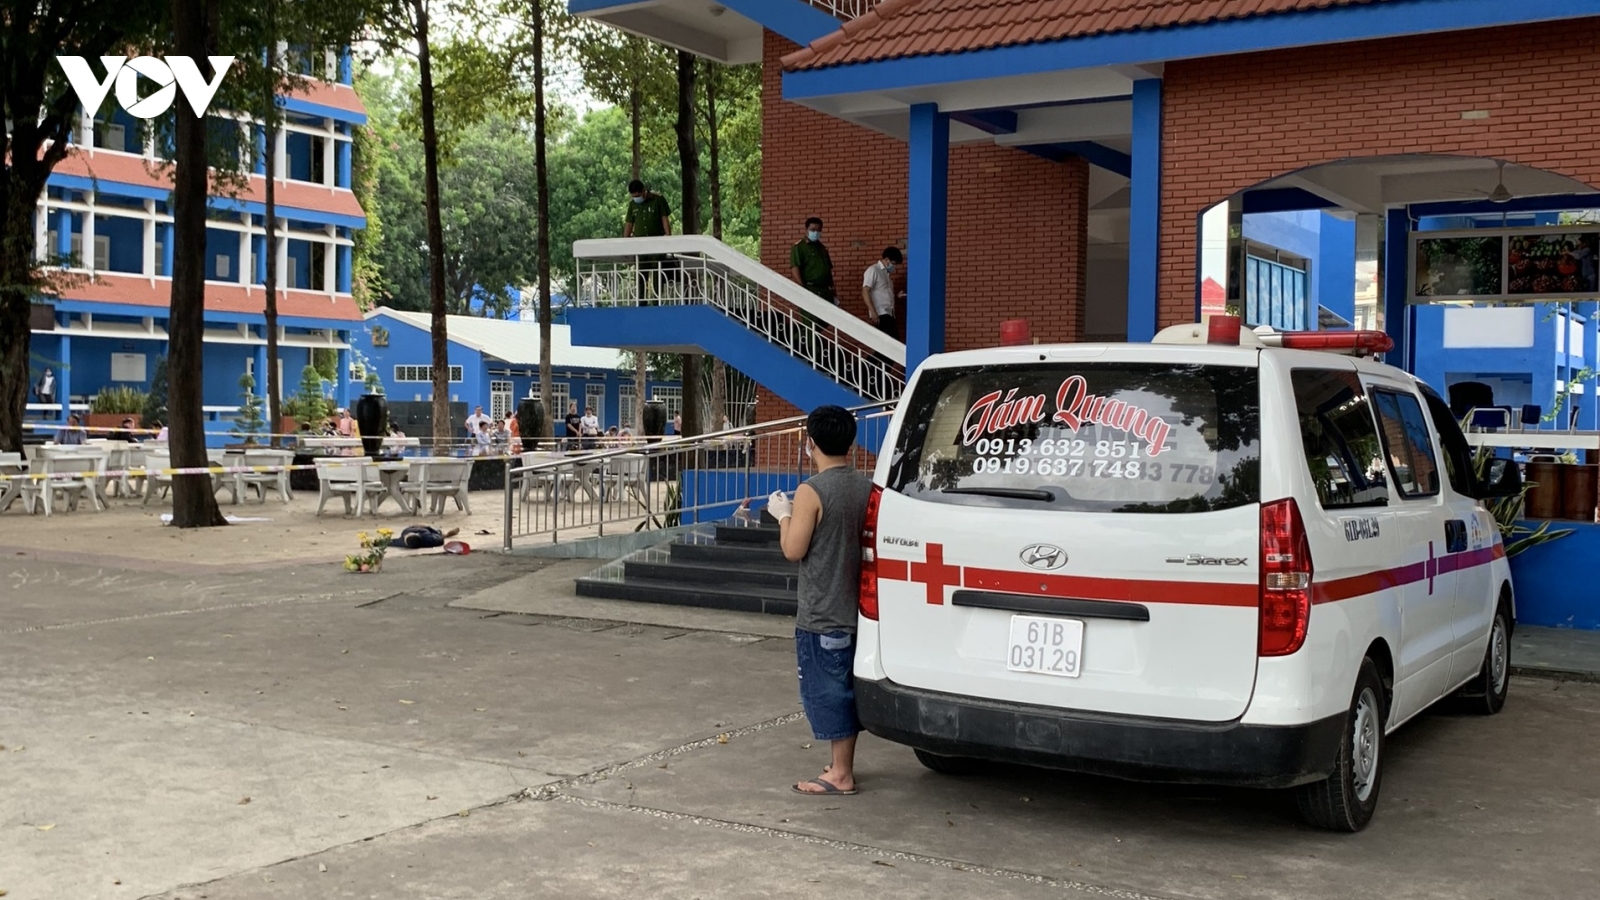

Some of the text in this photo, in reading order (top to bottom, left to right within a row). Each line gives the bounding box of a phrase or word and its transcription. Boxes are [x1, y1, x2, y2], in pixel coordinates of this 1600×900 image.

[963, 375, 1170, 457] Tám Quang
[976, 439, 1142, 459] 0913.632 851
[972, 457, 1081, 477] 0919.637
[1093, 459, 1141, 479] 748
[1170, 463, 1213, 485] 778
[1186, 553, 1248, 567] Starex
[1028, 621, 1064, 647] 61B
[1010, 644, 1077, 673] 031.29
